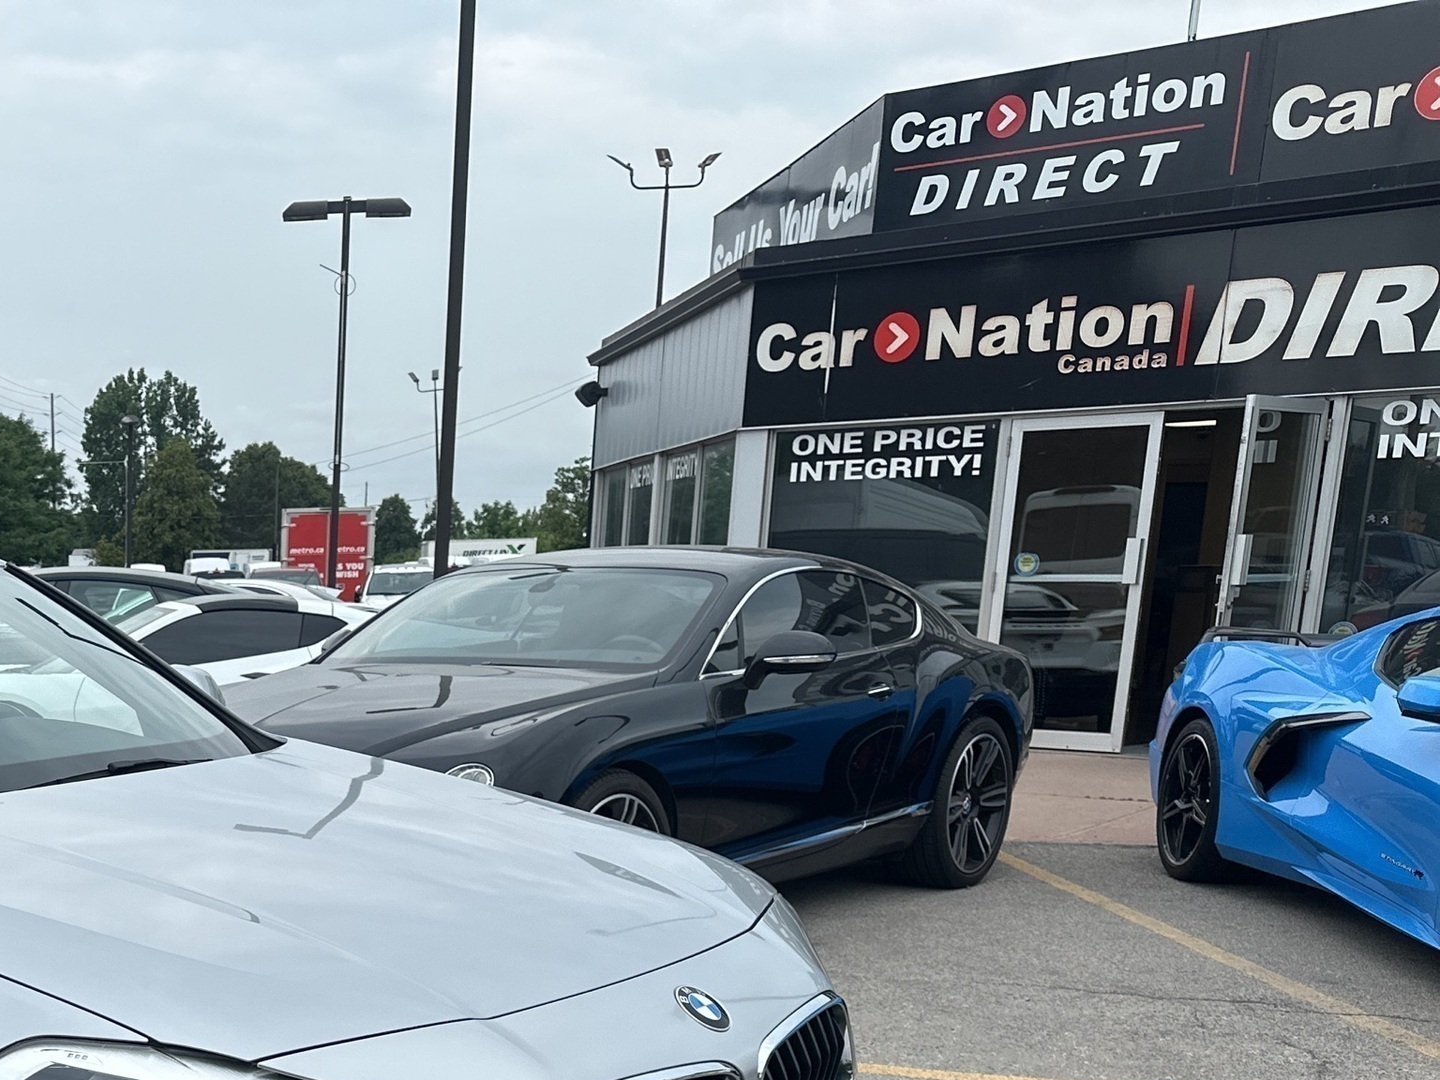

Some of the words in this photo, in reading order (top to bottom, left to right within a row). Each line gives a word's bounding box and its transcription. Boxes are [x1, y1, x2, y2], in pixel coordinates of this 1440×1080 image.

[890, 110, 983, 153] Car
[1028, 71, 1227, 133] Nation
[1271, 82, 1413, 141] Car
[779, 193, 826, 246] Your
[827, 141, 880, 230] Car!
[909, 140, 1181, 216] DIRECT
[755, 322, 868, 373] Car
[924, 294, 1176, 361] Nation
[1193, 264, 1440, 366] DIR
[1057, 348, 1168, 375] Canada
[791, 431, 864, 457] ONE
[872, 424, 987, 453] PRICE
[789, 453, 982, 483] INTEGRITY!
[289, 547, 325, 555] metro.ca
[345, 562, 365, 571] YOU
[335, 570, 360, 579] WISH
